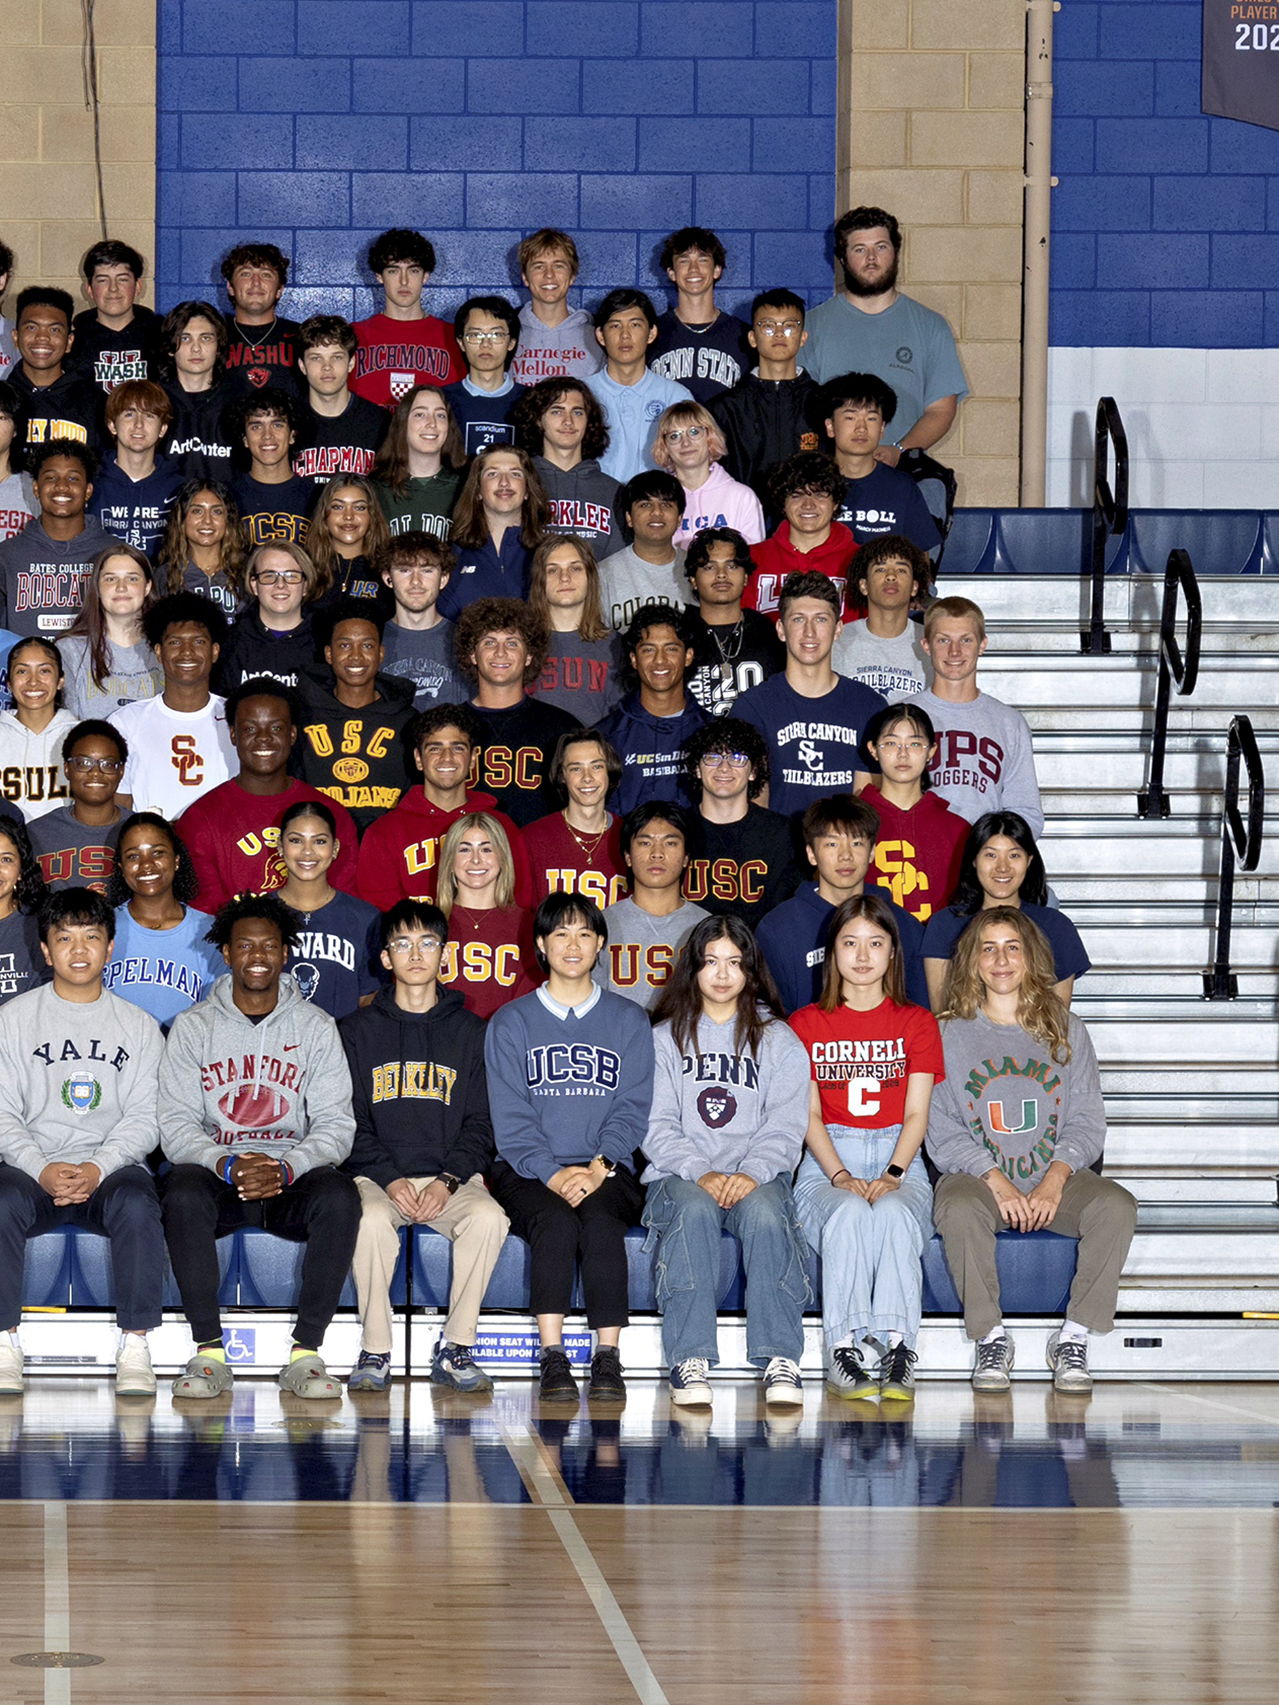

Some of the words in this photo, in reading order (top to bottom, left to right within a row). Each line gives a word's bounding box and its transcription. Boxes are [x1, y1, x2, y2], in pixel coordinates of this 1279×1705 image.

[1230, 5, 1278, 20] PLAYER
[94, 361, 148, 382] WASH
[355, 344, 451, 380] RICHMOND
[475, 425, 506, 433] scandium
[483, 434, 495, 443] 21
[292, 446, 376, 478] CHAPMAN
[111, 506, 129, 518] WE
[133, 506, 160, 518] ARE
[29, 563, 57, 574] BATES
[702, 665, 712, 704] CANYON
[856, 665, 882, 674] SIERRA
[883, 666, 912, 677] CANYON
[808, 722, 857, 747] CANYON
[171, 735, 204, 786] SC
[636, 754, 655, 765] UC
[797, 740, 824, 770] SC
[681, 858, 768, 904] USC
[609, 943, 682, 988] US
[33, 1039, 132, 1073] YALE
[525, 1043, 621, 1091] UCSB
[201, 1054, 306, 1093] STANFOR
[815, 1060, 906, 1082] UNIVERSITY
[964, 1056, 1061, 1100] MIAMI
[533, 1088, 563, 1097] SANTA
[565, 1088, 606, 1097] BARBARA
[848, 1076, 881, 1117] C
[987, 1099, 1037, 1134] U
[500, 1338, 523, 1346] SEAT
[564, 1339, 590, 1347] MADE
[506, 1349, 533, 1358] UPON
